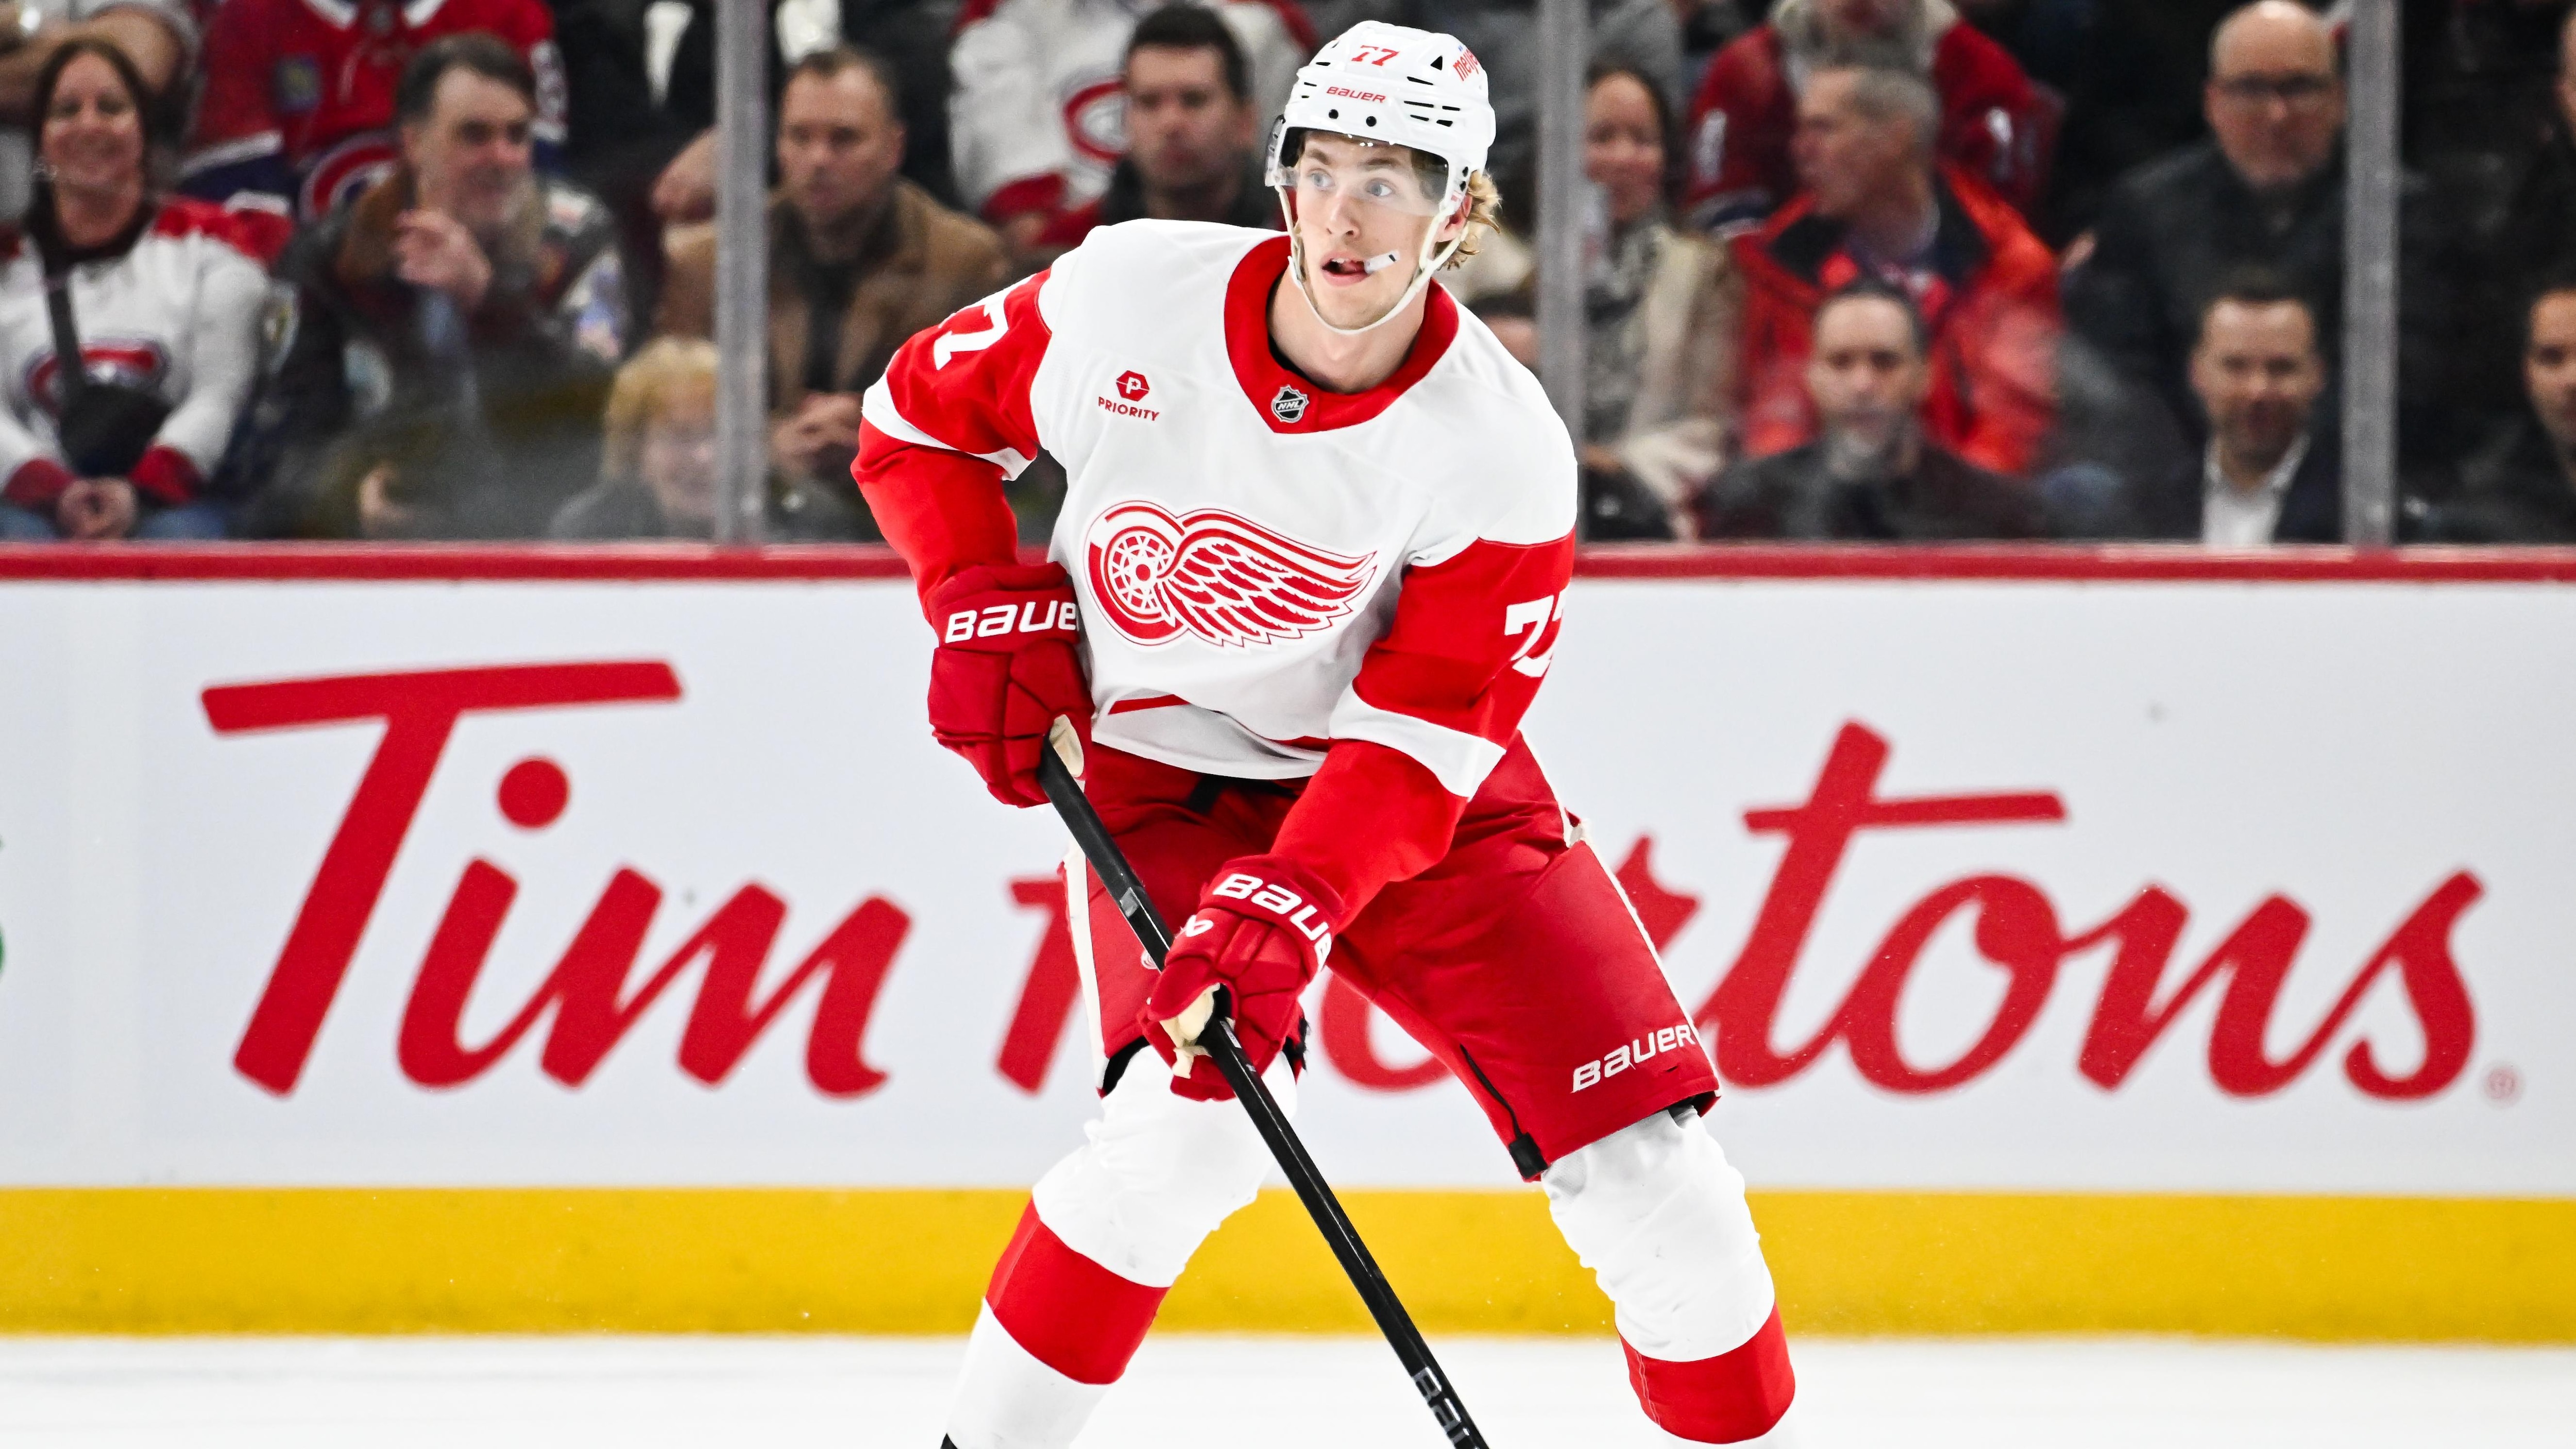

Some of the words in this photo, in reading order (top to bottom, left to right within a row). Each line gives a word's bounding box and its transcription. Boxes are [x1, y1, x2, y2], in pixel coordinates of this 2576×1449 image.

[1351, 45, 1398, 66] 77
[1098, 396, 1160, 421] PRIORITY
[200, 660, 913, 1099] Tim
